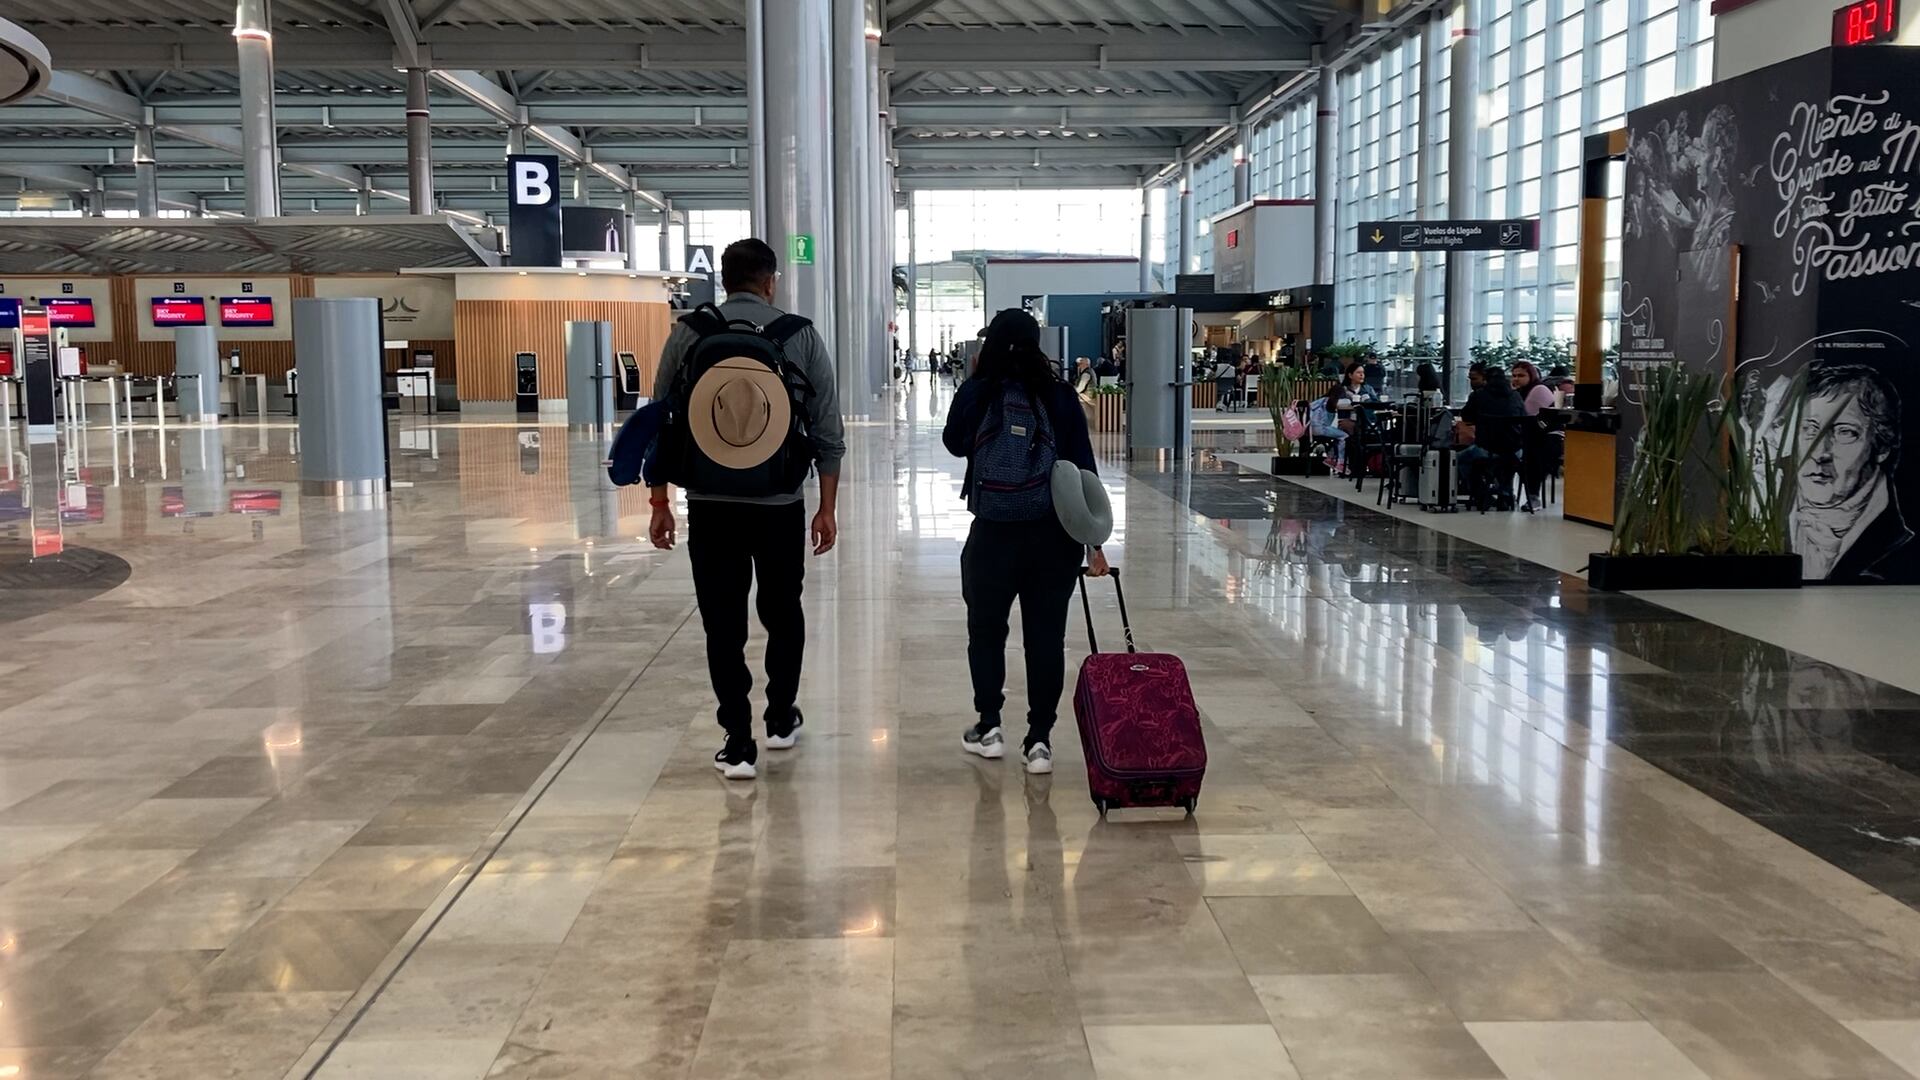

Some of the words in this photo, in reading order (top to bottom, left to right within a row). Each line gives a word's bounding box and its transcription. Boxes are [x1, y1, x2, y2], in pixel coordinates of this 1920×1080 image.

[1790, 90, 1890, 158] Niente
[1883, 112, 1901, 130] di
[1858, 156, 1881, 172] nel
[515, 161, 552, 205] B
[1834, 180, 1909, 237] fatto
[1444, 237, 1463, 245] flights
[1447, 227, 1455, 235] de
[1456, 227, 1482, 236] Llegada
[688, 248, 713, 273] A
